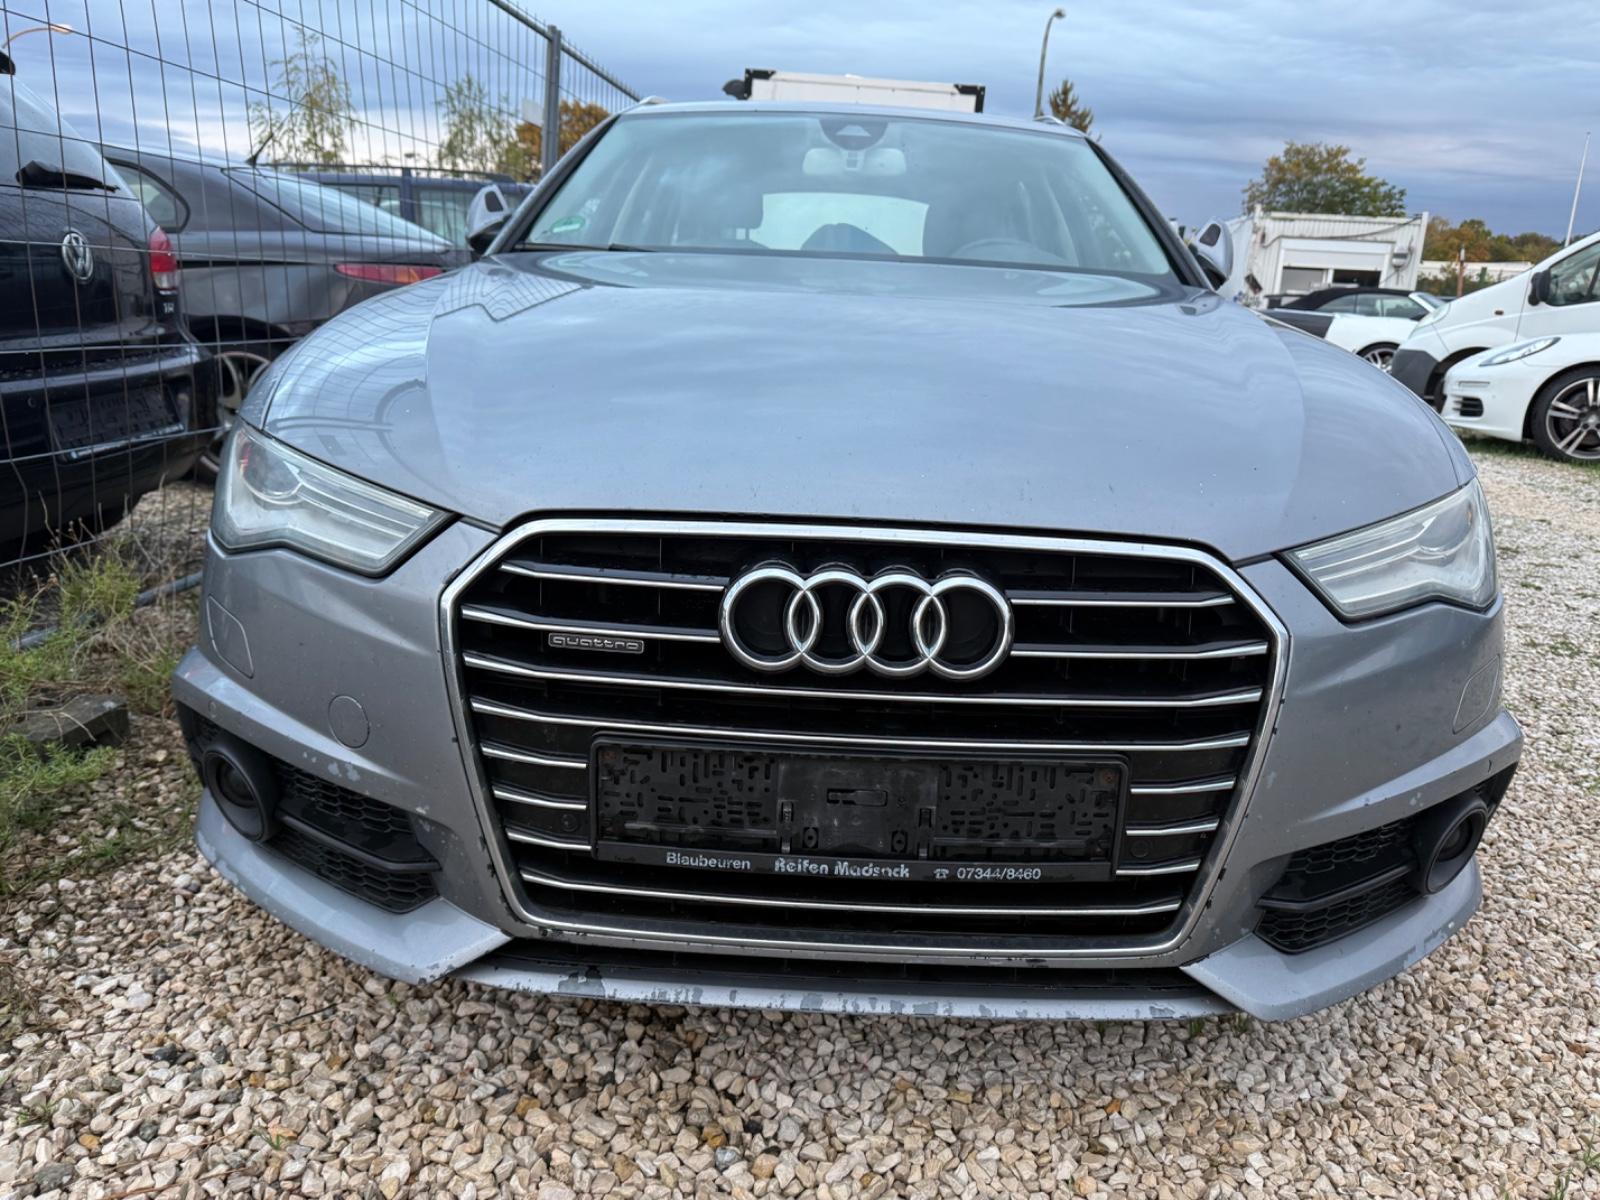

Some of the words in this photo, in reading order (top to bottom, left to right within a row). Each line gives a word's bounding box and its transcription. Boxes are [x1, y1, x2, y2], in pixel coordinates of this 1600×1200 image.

[552, 636, 640, 650] quattro
[666, 851, 751, 870] Blaubeuren
[774, 857, 829, 875] Reifen
[956, 867, 1042, 880] 07344/8460
